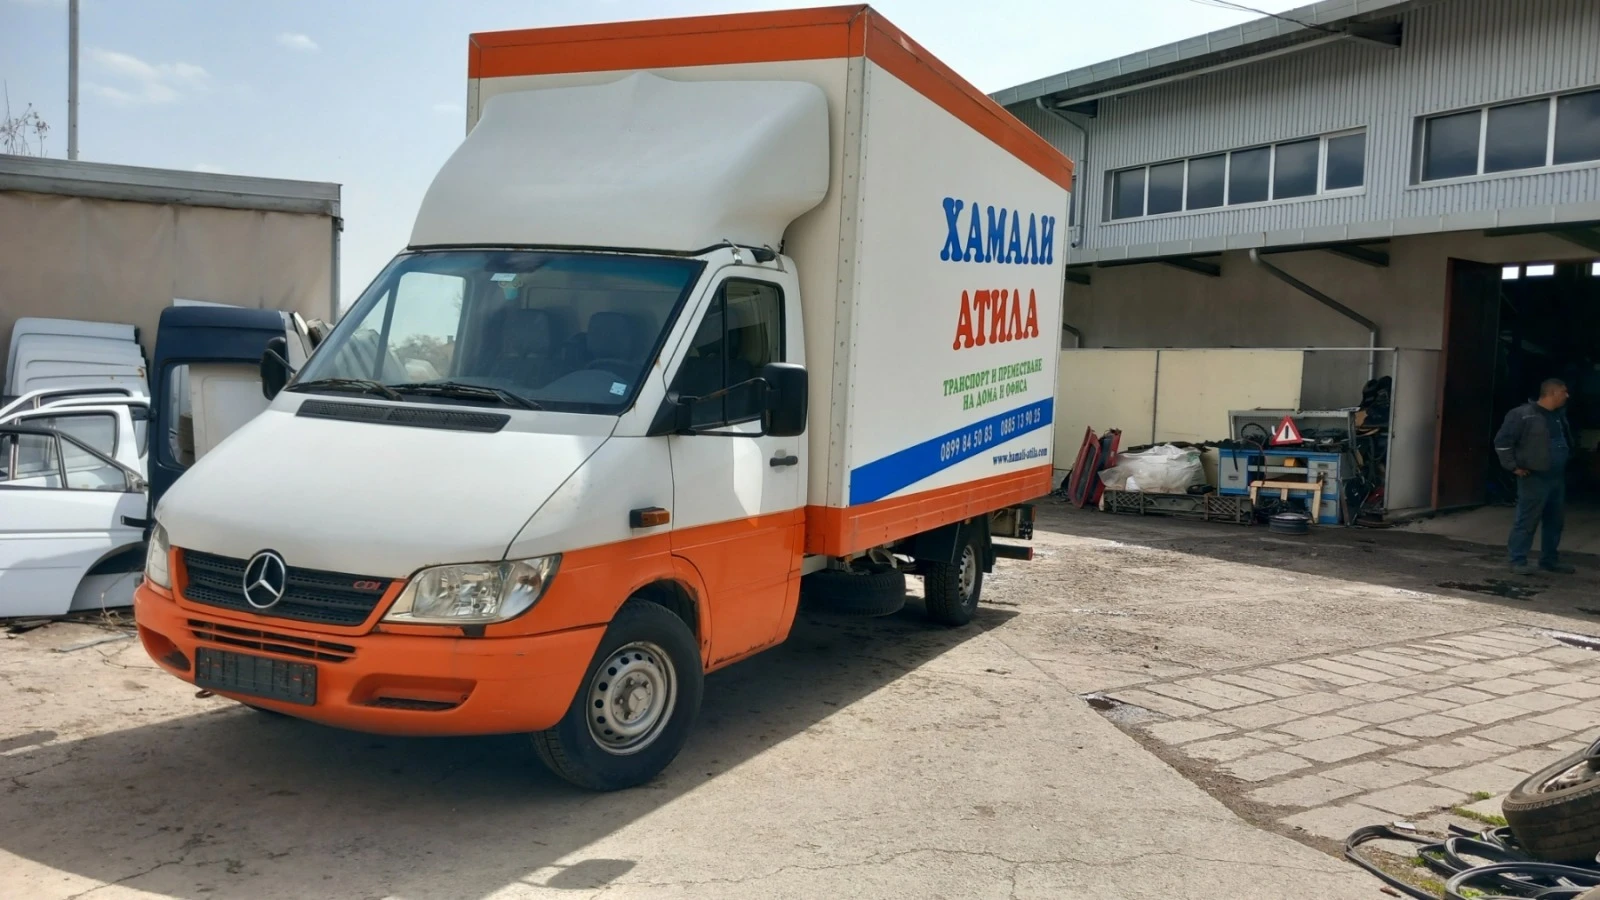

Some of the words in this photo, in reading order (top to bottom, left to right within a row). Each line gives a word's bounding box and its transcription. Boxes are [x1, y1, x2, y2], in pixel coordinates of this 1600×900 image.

[940, 197, 1055, 265] ХАМАЛИ
[953, 288, 1039, 350] АТИЛА
[943, 370, 990, 396] ТРАНСПОРТ
[998, 358, 1042, 382] ПРЕМЕСТВАНЕ
[963, 393, 974, 410] НА
[976, 387, 998, 407] ДОМА
[1006, 379, 1028, 397] ОФИСА
[940, 437, 960, 462] 0899
[962, 433, 972, 452] 84
[973, 429, 983, 448] 50
[984, 424, 993, 443] 83
[1000, 416, 1015, 436] 0885
[1017, 412, 1024, 429] 13
[1025, 410, 1033, 426] 90
[992, 447, 1048, 466] www.hamali-atila.com
[353, 580, 381, 590] CDI
